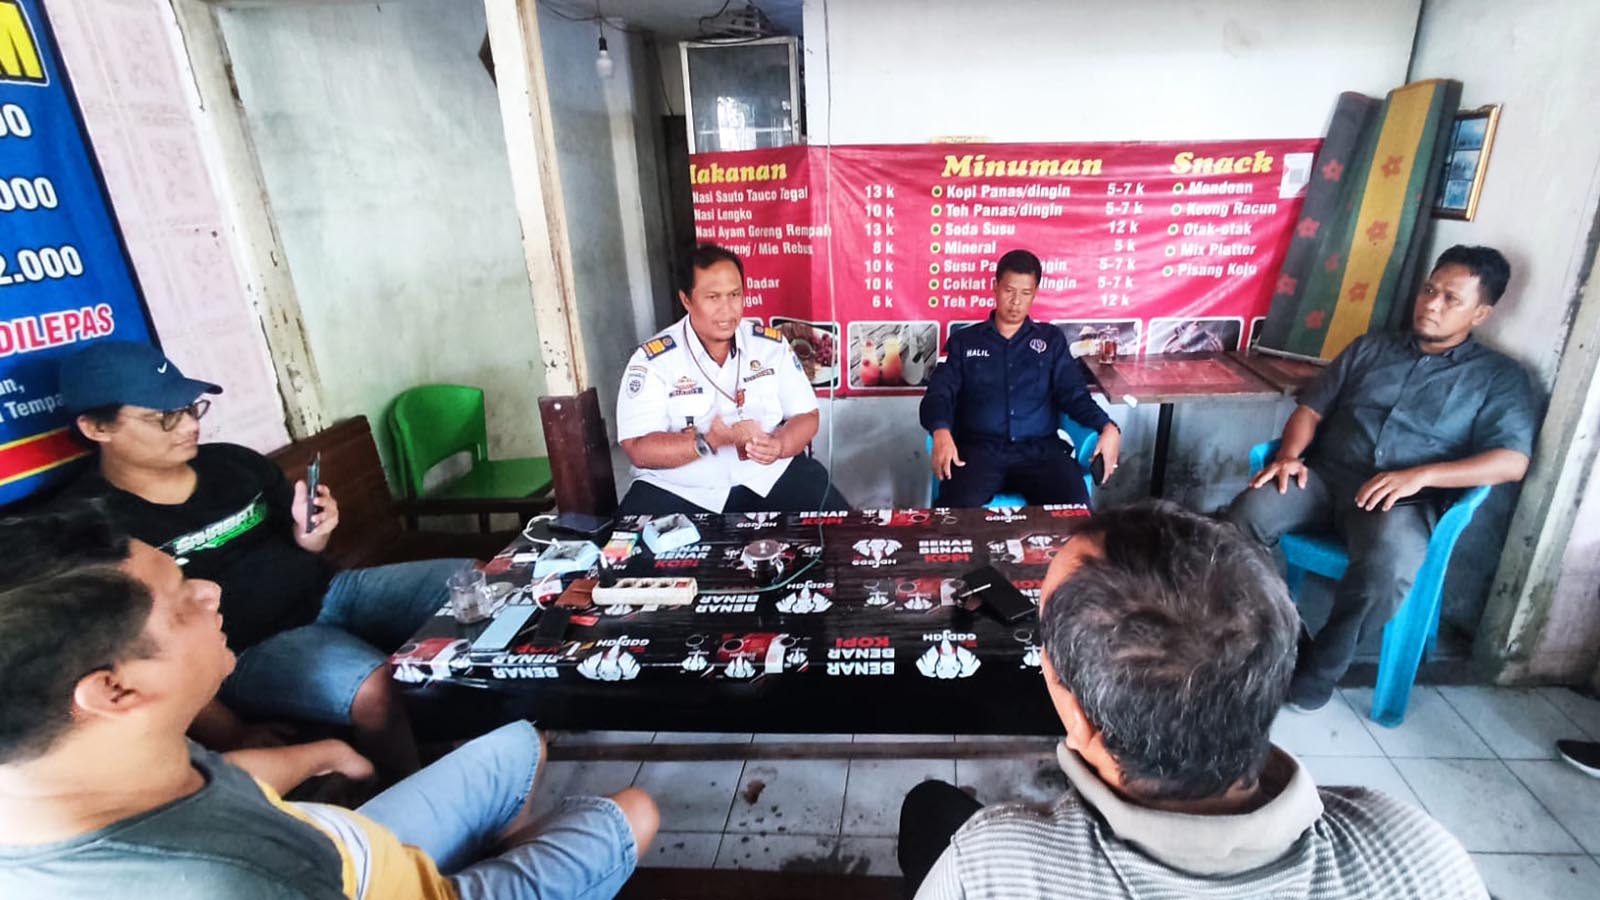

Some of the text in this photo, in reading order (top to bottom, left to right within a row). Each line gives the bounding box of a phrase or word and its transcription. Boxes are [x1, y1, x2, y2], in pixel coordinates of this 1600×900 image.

[941, 154, 1103, 177] Minuman
[1170, 151, 1273, 174] Snack
[865, 184, 894, 199] 13 k
[947, 184, 1071, 200] Kopi Panas/dingin
[1107, 183, 1145, 196] 5-7 k
[1189, 182, 1253, 194] Mendoan
[692, 186, 808, 204] Nasi Sauto Tauco Tegal
[694, 207, 752, 222] Nasi Lengko
[865, 203, 894, 217] 10 k
[946, 203, 1063, 218] Teh Panas/dingin
[1105, 202, 1144, 215] 5-7 k
[1187, 202, 1277, 217] Keong Racun
[695, 225, 715, 238] Nasi
[718, 225, 745, 240] Ayam
[748, 225, 782, 239] Goreng
[865, 222, 894, 236] 13 k
[945, 222, 1016, 235] Soda Susu
[1109, 221, 1138, 234] 12 k
[1183, 223, 1252, 236] Otak-otak
[759, 243, 779, 255] Mie
[783, 242, 813, 255] Rebus
[873, 241, 893, 254] 8 k
[945, 241, 996, 254] Mineral
[1113, 240, 1136, 252] 5 k
[1180, 244, 1256, 256] Mix Platter
[865, 260, 894, 273] 10 k
[944, 260, 976, 272] Susu
[1099, 260, 1136, 271] 5-7 k
[1178, 263, 1257, 278] Pisang Keju
[746, 277, 780, 289] Dadar
[865, 277, 893, 290] 10 k
[943, 278, 986, 290] Coklat
[1098, 277, 1134, 289] 5-7 k
[873, 295, 893, 308] 6 k
[942, 296, 965, 308] Teh
[1101, 295, 1130, 306] 12 k
[655, 560, 700, 568] KOPI
[925, 554, 970, 563] KOPI
[699, 595, 759, 603] BENAR
[695, 604, 757, 613] BENAR
[836, 636, 890, 648] KOPI
[827, 648, 895, 659] BENAR
[492, 667, 560, 678] BENAR
[826, 661, 895, 675] BENAR
